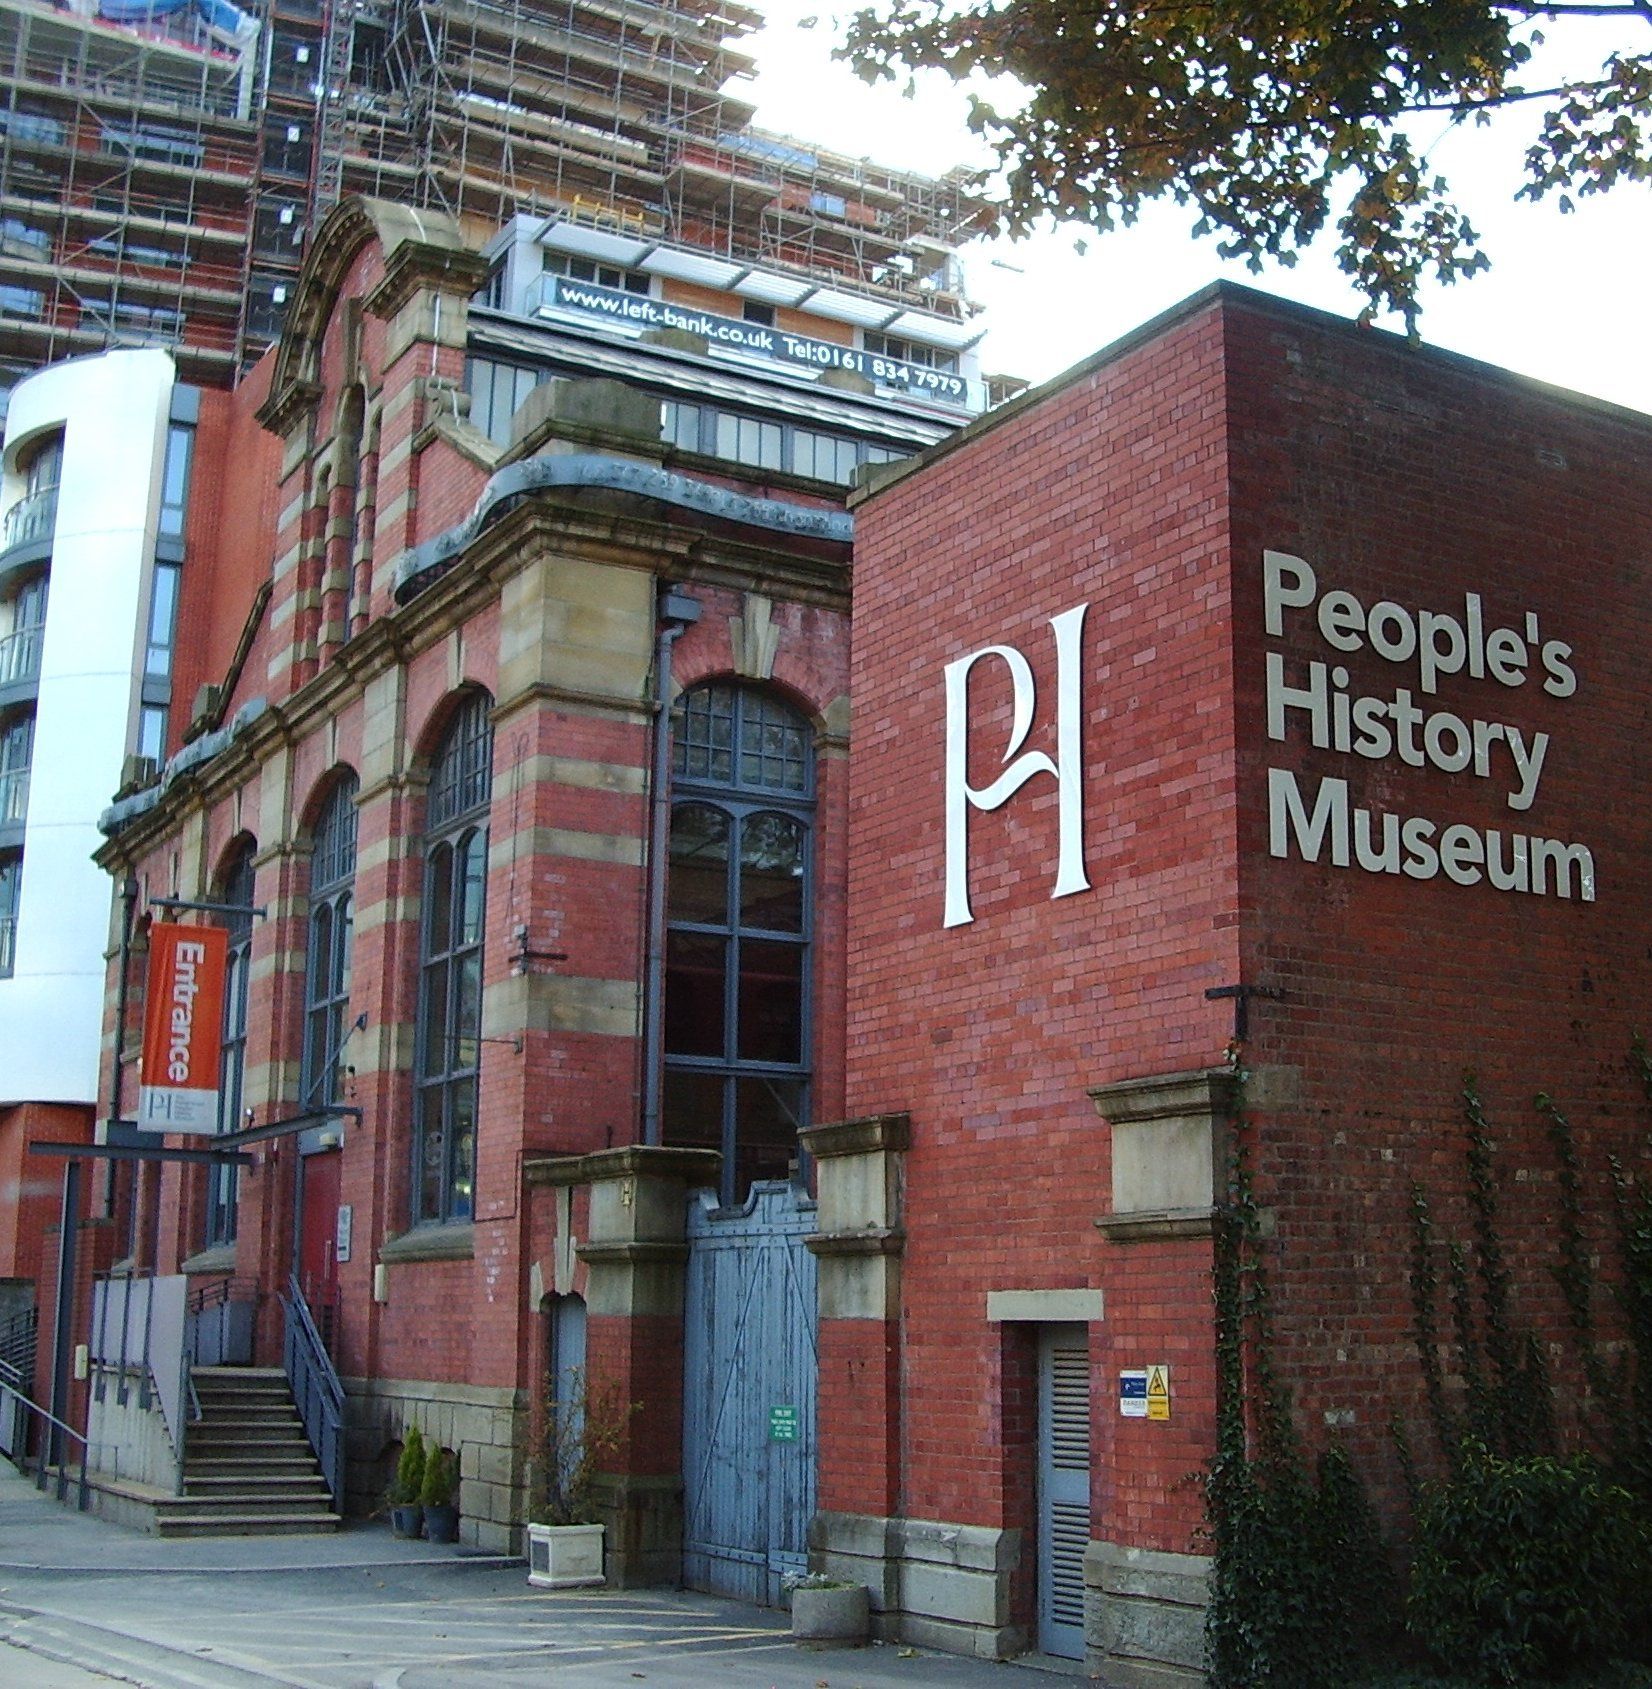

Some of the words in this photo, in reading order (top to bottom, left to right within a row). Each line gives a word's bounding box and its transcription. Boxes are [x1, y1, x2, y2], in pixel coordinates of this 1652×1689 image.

[561, 287, 773, 350] www.left-bank.co.uk
[783, 337, 863, 372] Tel:0161
[872, 359, 909, 383] 834
[915, 370, 962, 395] 7979
[1263, 549, 1577, 698] People's
[1265, 651, 1549, 810] History
[1268, 767, 1596, 901] Museum
[168, 941, 204, 1083] Entrance
